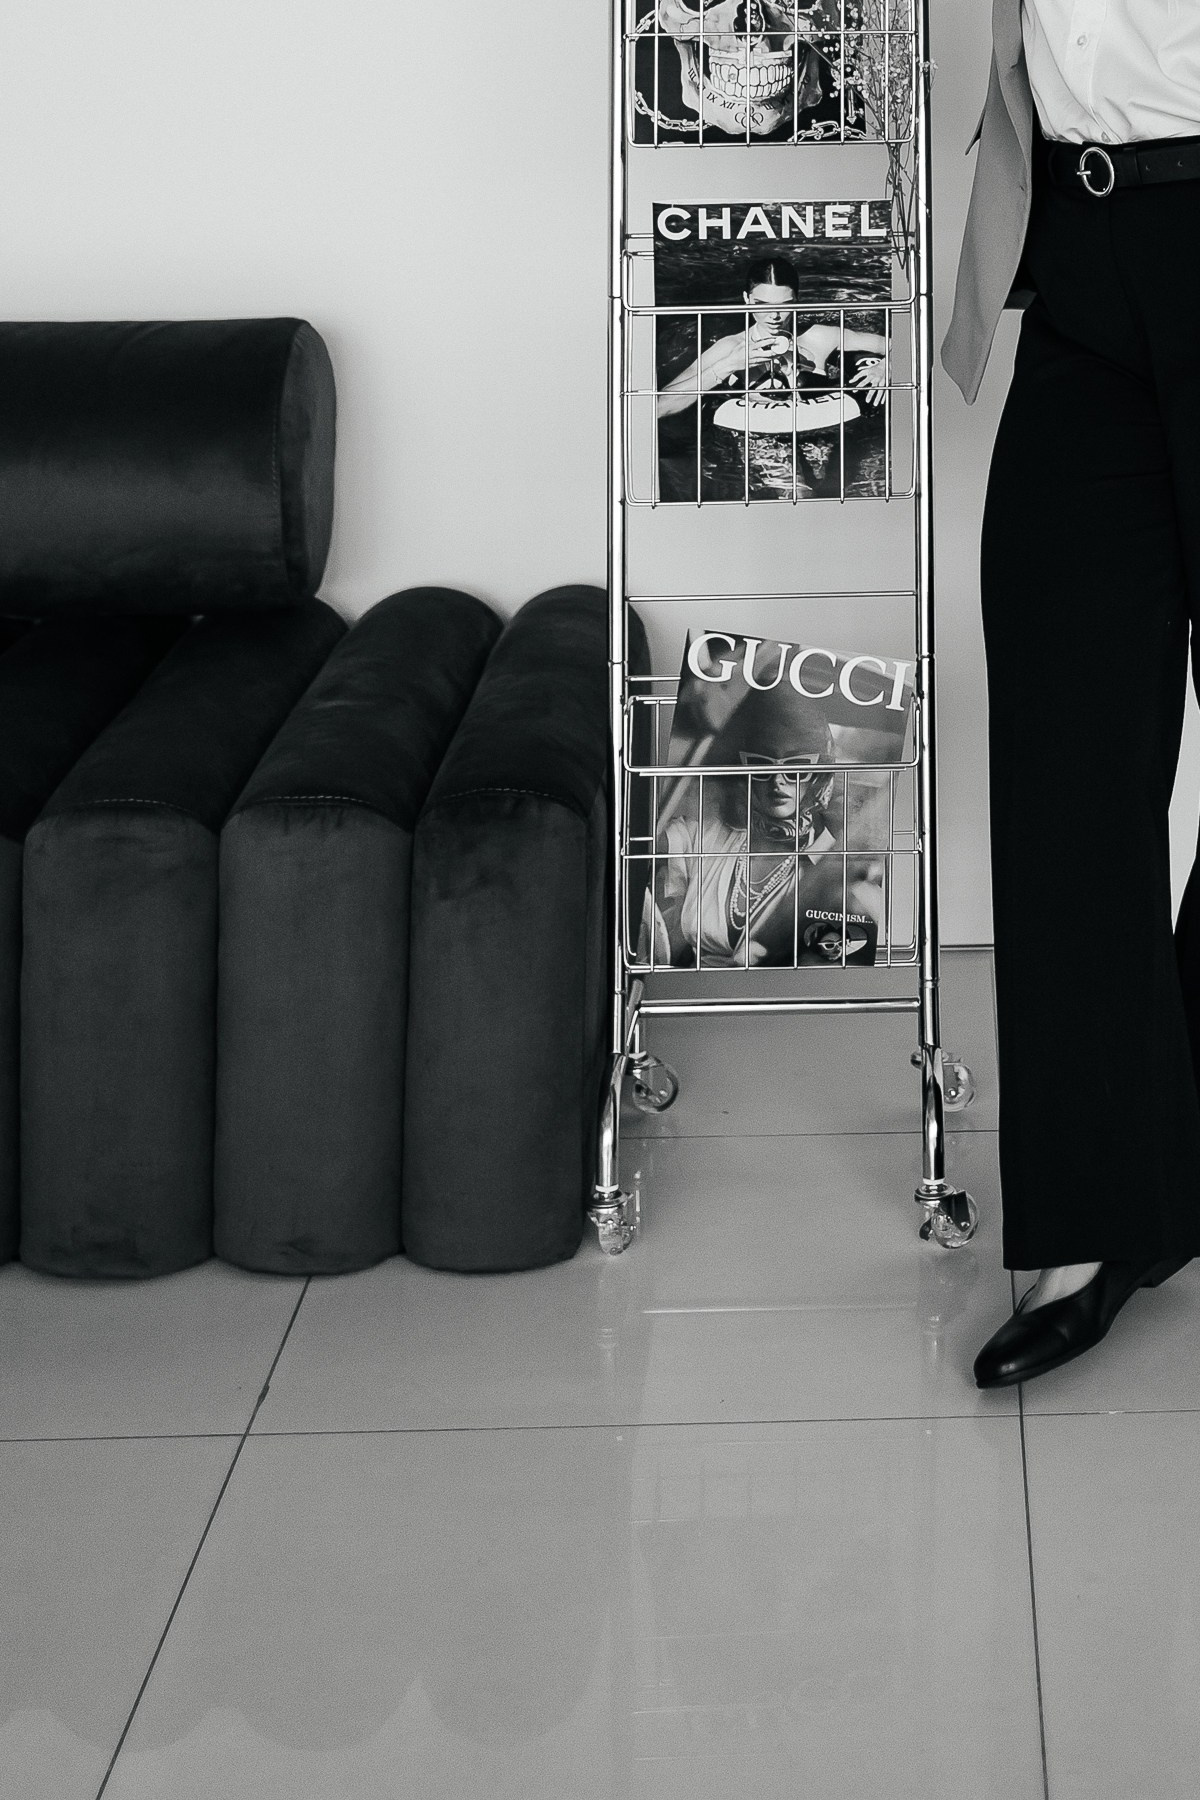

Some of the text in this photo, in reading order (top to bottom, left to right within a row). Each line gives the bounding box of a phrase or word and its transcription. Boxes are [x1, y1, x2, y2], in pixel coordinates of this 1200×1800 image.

[719, 100, 736, 110] XII
[656, 203, 888, 241] CHANEL
[687, 632, 912, 712] GUCCI
